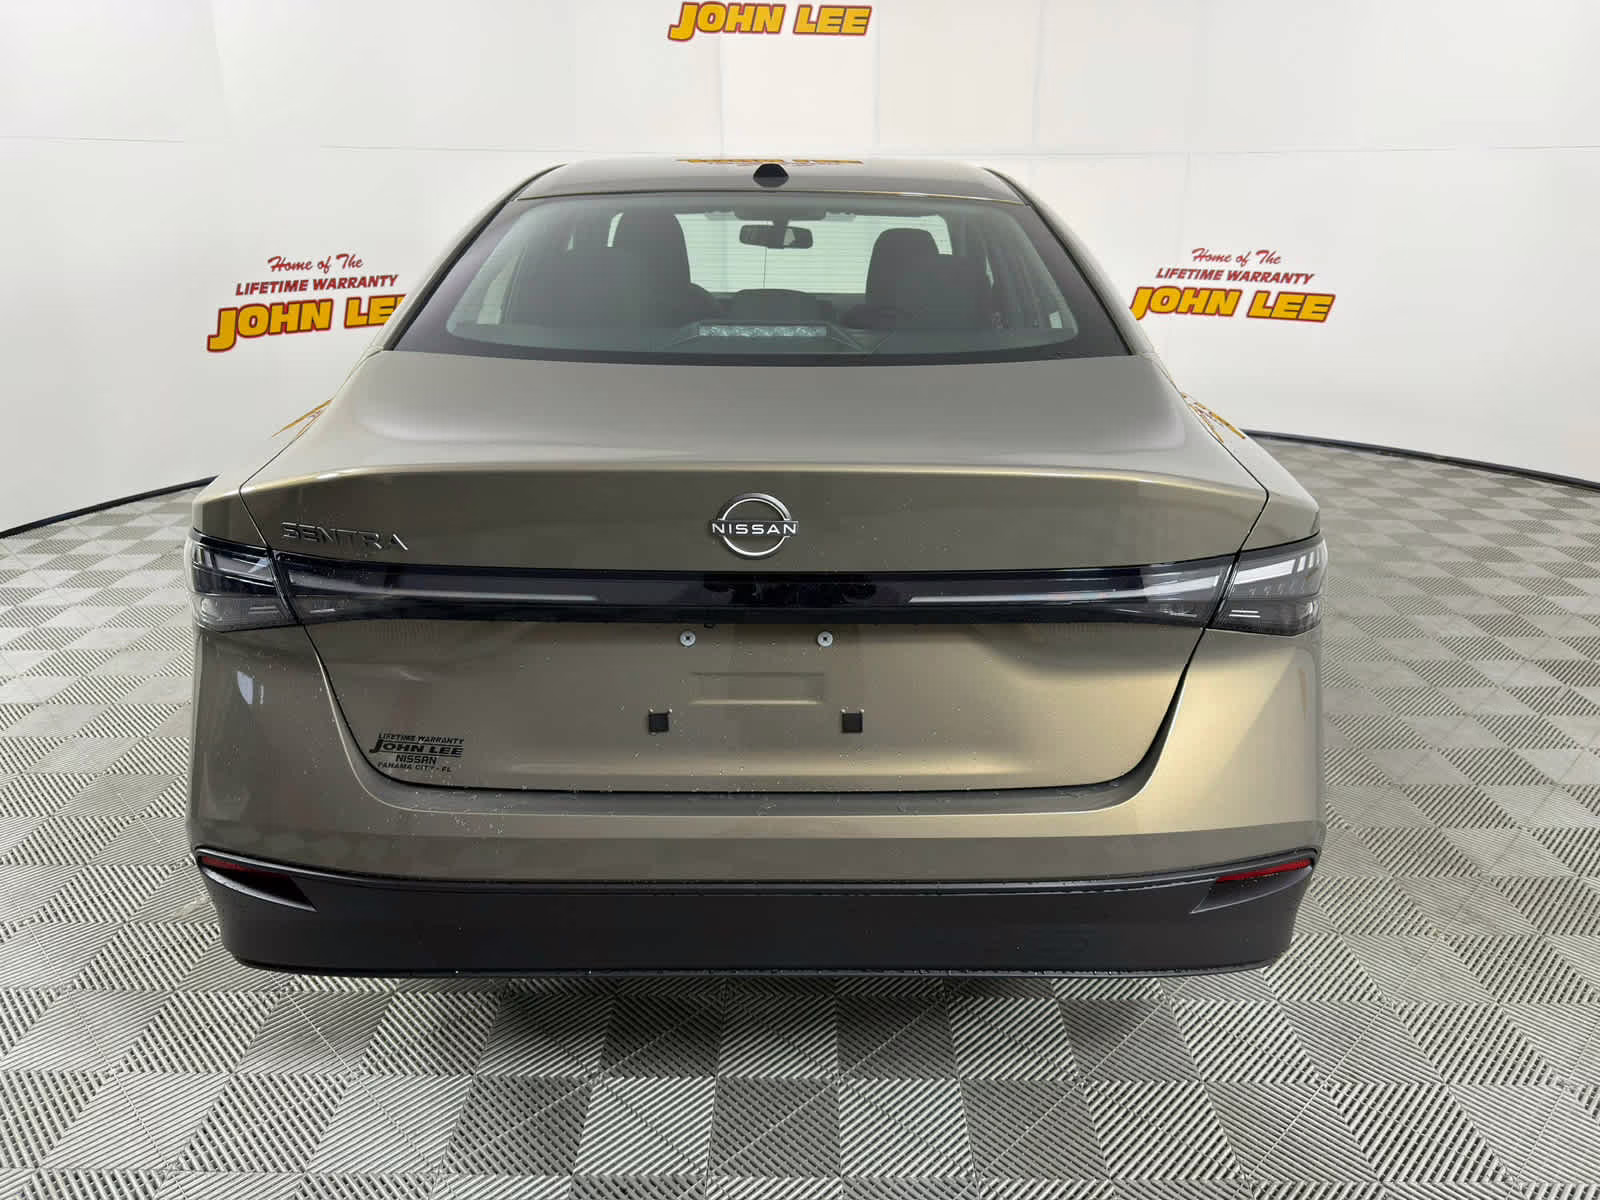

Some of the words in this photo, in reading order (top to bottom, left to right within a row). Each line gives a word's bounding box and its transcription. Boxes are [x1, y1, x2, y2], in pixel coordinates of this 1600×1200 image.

[668, 1, 786, 41] JOHN
[793, 4, 872, 36] LEE
[267, 255, 313, 273] Home
[317, 256, 332, 273] of
[335, 253, 363, 269] The
[1191, 247, 1232, 263] Home
[1235, 251, 1250, 267] of
[1255, 249, 1281, 265] The
[235, 279, 309, 296] LIFETIME
[312, 274, 399, 291] WARRANTY
[1155, 267, 1224, 281] LIFETIME
[1226, 269, 1315, 285] WARRANTY
[1129, 285, 1243, 321] JOHN
[1247, 290, 1336, 323] LEE
[207, 298, 334, 353] JOHN
[343, 294, 406, 329] LE
[281, 521, 408, 551] SENTRA
[711, 522, 797, 535] NISSAN
[369, 739, 425, 754] JOHN
[430, 746, 464, 757] LEE
[378, 733, 416, 742] LIFETIME
[418, 735, 464, 745] WARRANTY
[377, 761, 413, 770] PANAMA
[395, 754, 438, 765] NISSAN
